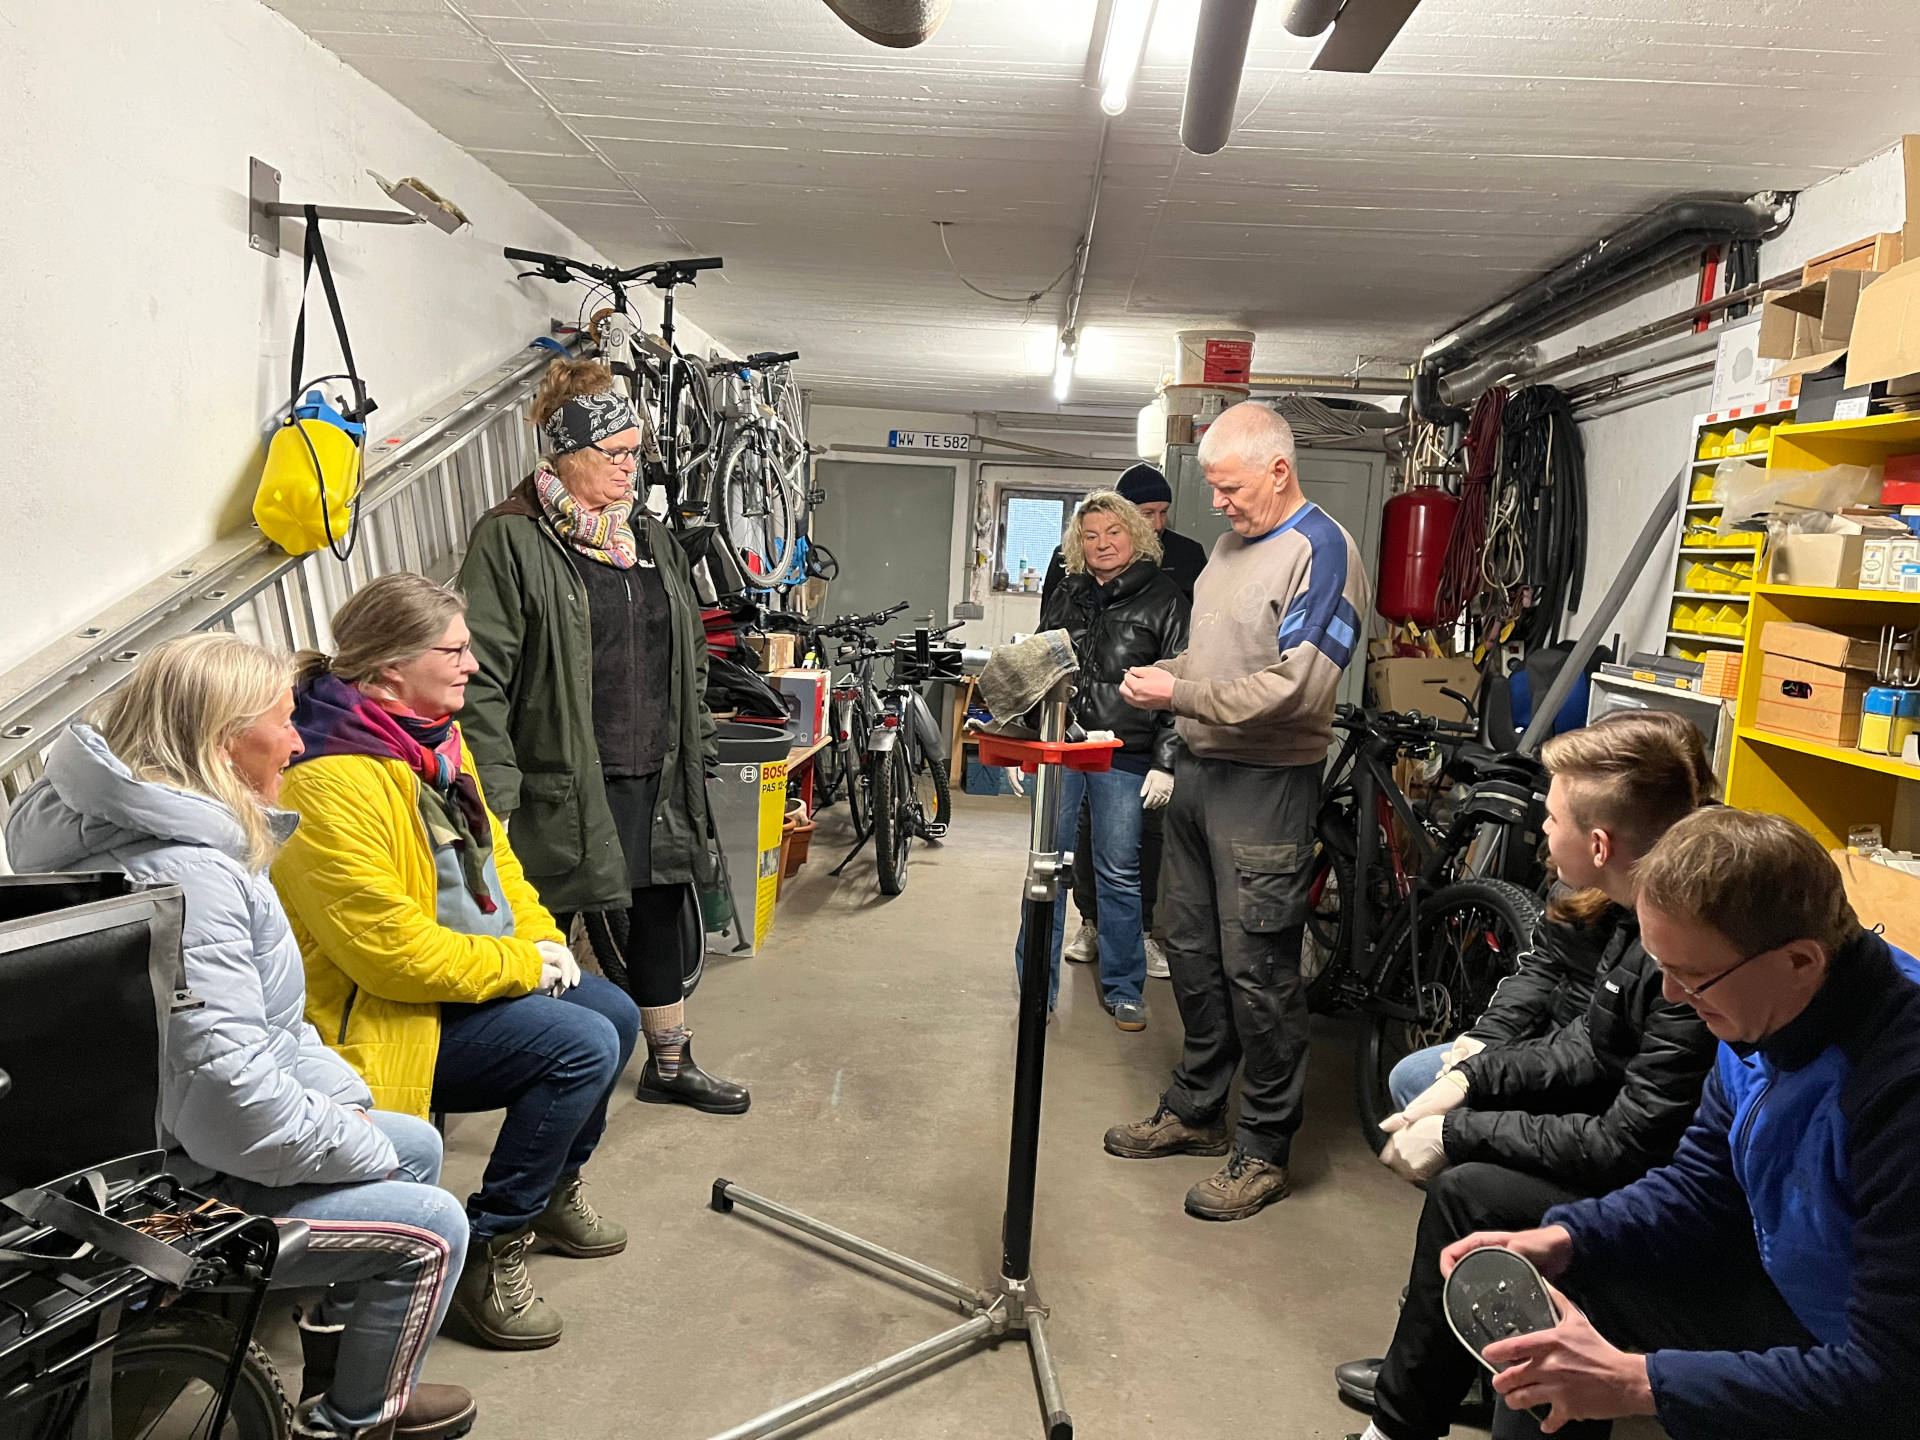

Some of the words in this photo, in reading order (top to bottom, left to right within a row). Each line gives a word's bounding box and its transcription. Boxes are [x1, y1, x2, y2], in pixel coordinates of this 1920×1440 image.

[898, 433, 915, 446] WW
[923, 434, 940, 448] TE
[943, 435, 968, 449] 582
[762, 782, 776, 793] PAS
